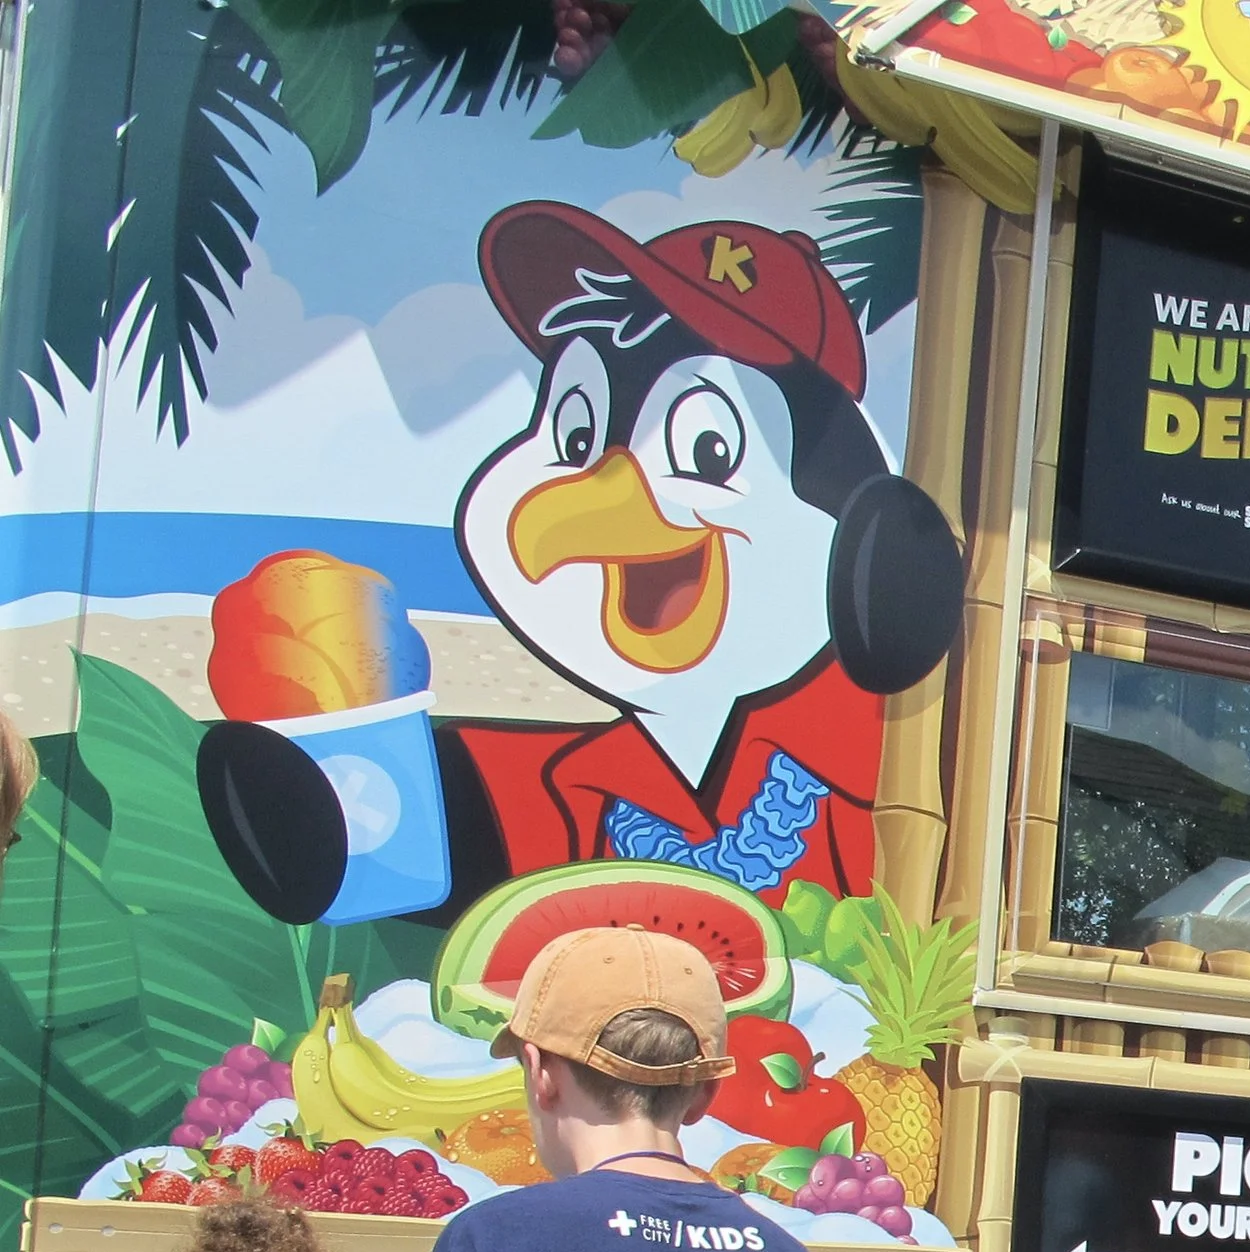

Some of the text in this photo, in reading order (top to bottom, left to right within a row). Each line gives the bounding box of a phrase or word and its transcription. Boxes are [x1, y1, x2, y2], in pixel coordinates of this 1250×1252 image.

[708, 235, 754, 293] K
[1153, 293, 1208, 330] WE
[640, 1214, 672, 1231] FREE
[642, 1228, 671, 1244] CITY
